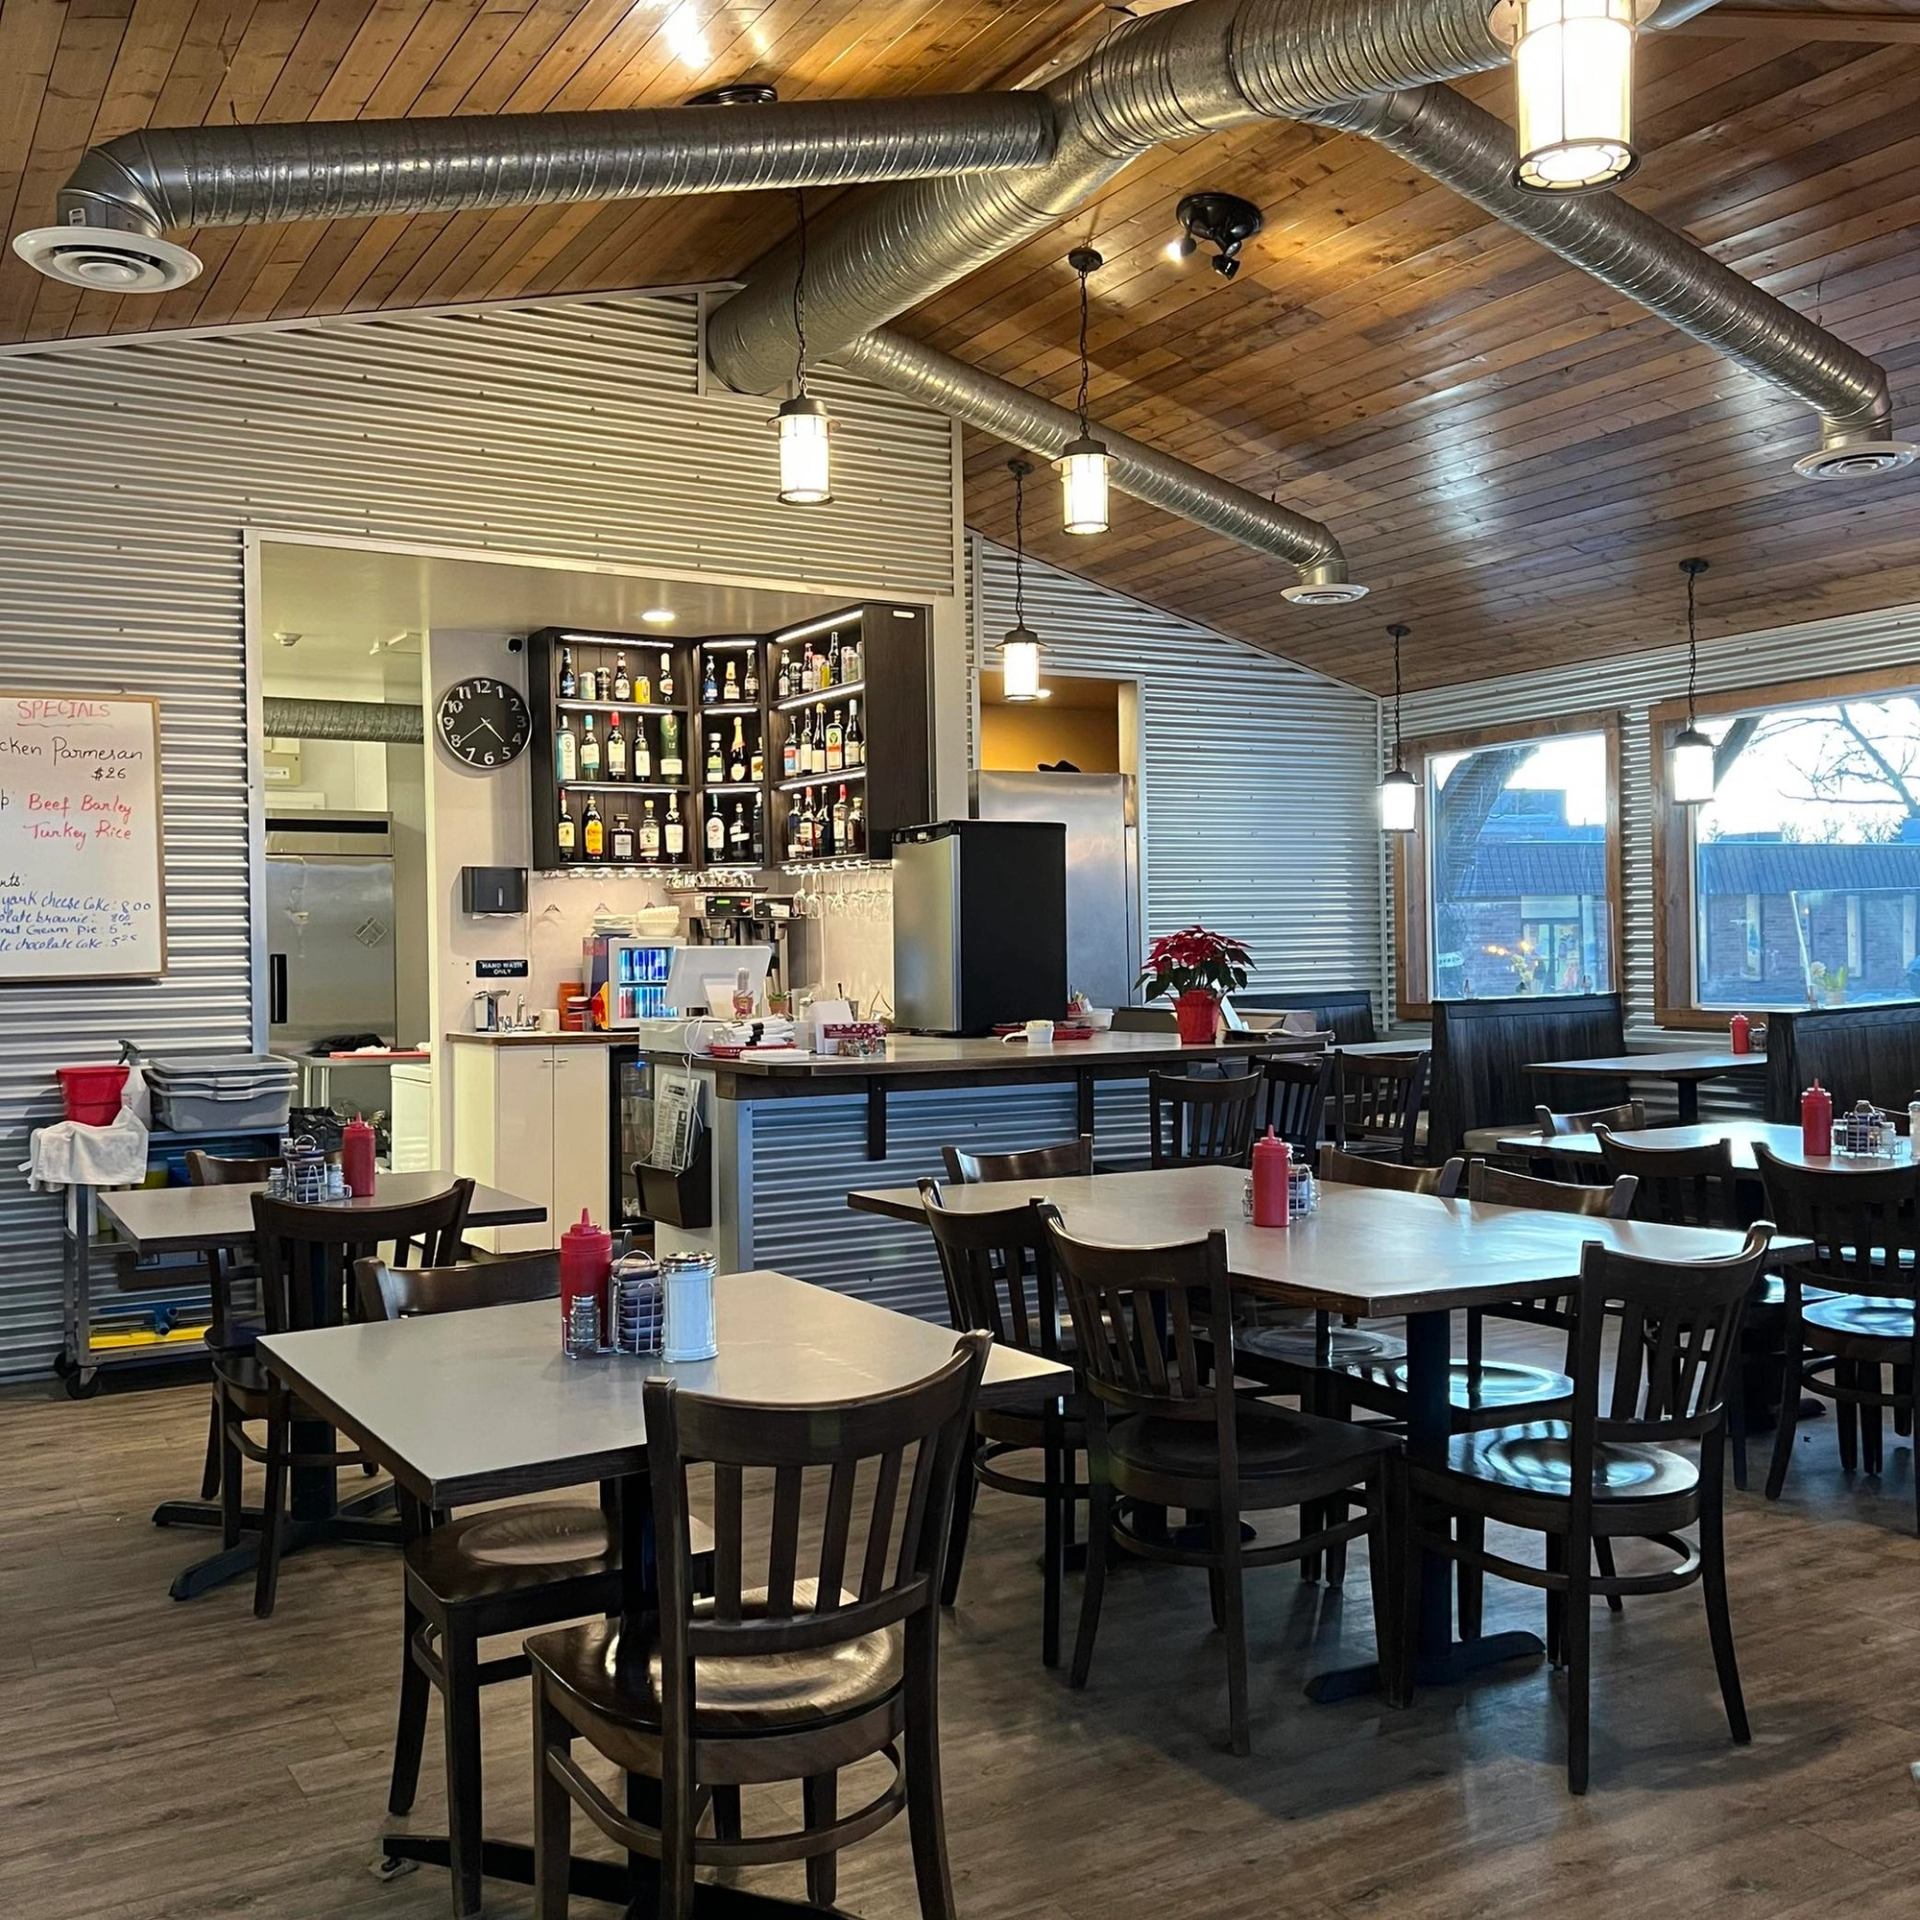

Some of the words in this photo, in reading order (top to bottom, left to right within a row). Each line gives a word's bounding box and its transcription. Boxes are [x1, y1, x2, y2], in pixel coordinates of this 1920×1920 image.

[456, 686, 471, 699] 11
[473, 680, 491, 694] 12
[496, 685, 504, 698] 1
[17, 700, 111, 719] SPECIALS
[447, 700, 464, 714] 10
[510, 698, 520, 711] 2
[444, 717, 454, 730] 9
[517, 716, 526, 728] 3
[450, 734, 462, 748] 8
[512, 732, 522, 745] 4
[52, 736, 142, 766] Parmesan
[466, 748, 476, 760] 7
[502, 747, 510, 760] 5
[484, 752, 494, 764] 6
[90, 766, 126, 782] $26
[28, 792, 71, 818] Beef
[80, 794, 132, 824] Barley
[22, 821, 86, 852] Turkey
[96, 820, 132, 840] Rice
[41, 892, 80, 910] cheese
